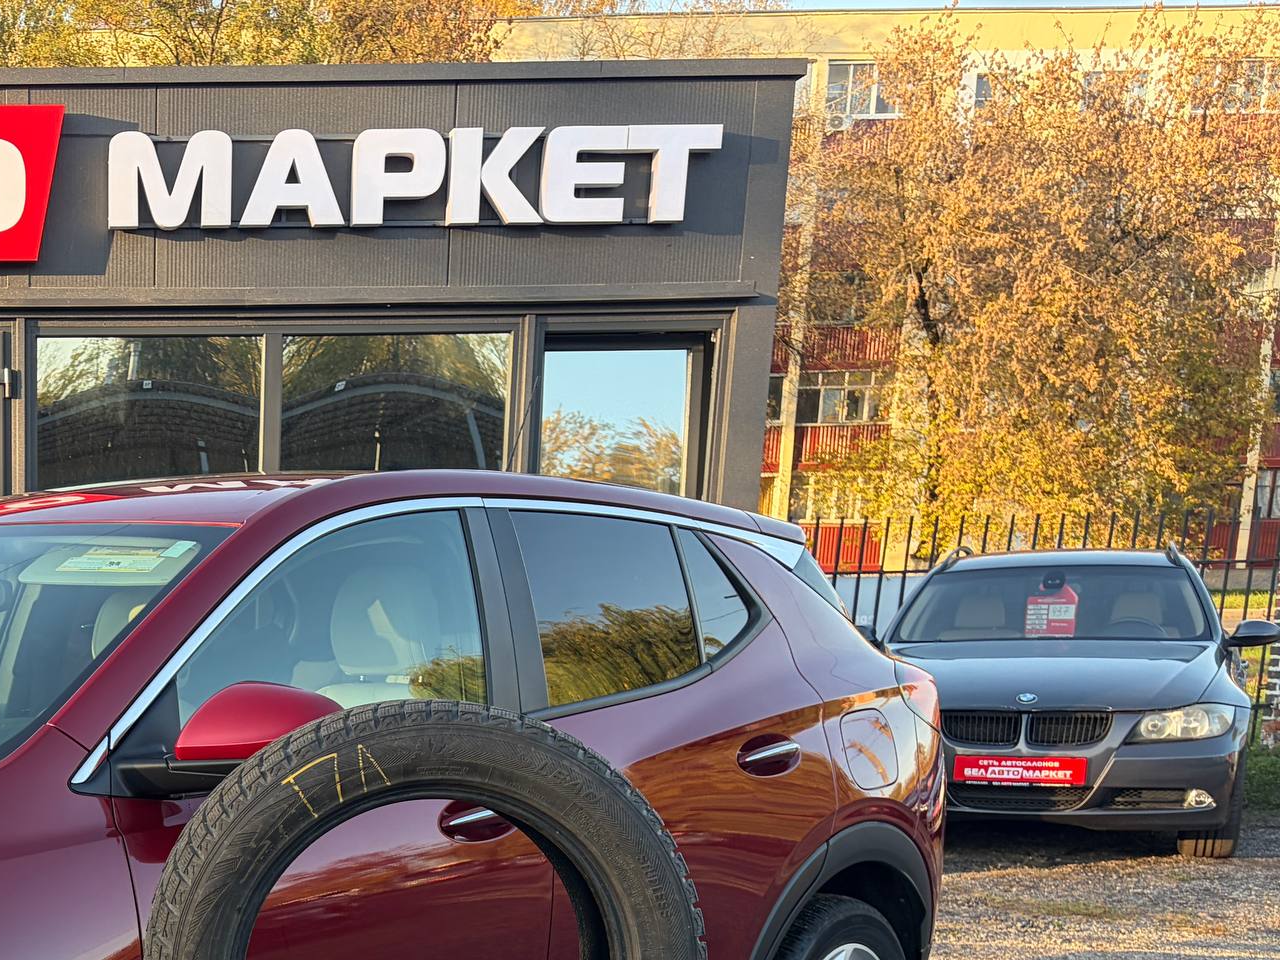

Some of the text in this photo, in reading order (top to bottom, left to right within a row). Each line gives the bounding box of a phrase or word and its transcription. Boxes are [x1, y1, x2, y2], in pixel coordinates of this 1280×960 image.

[107, 123, 724, 229] МАРКЕТ
[964, 768, 1073, 779] БЕЛ АВТО МАРКЕТ
